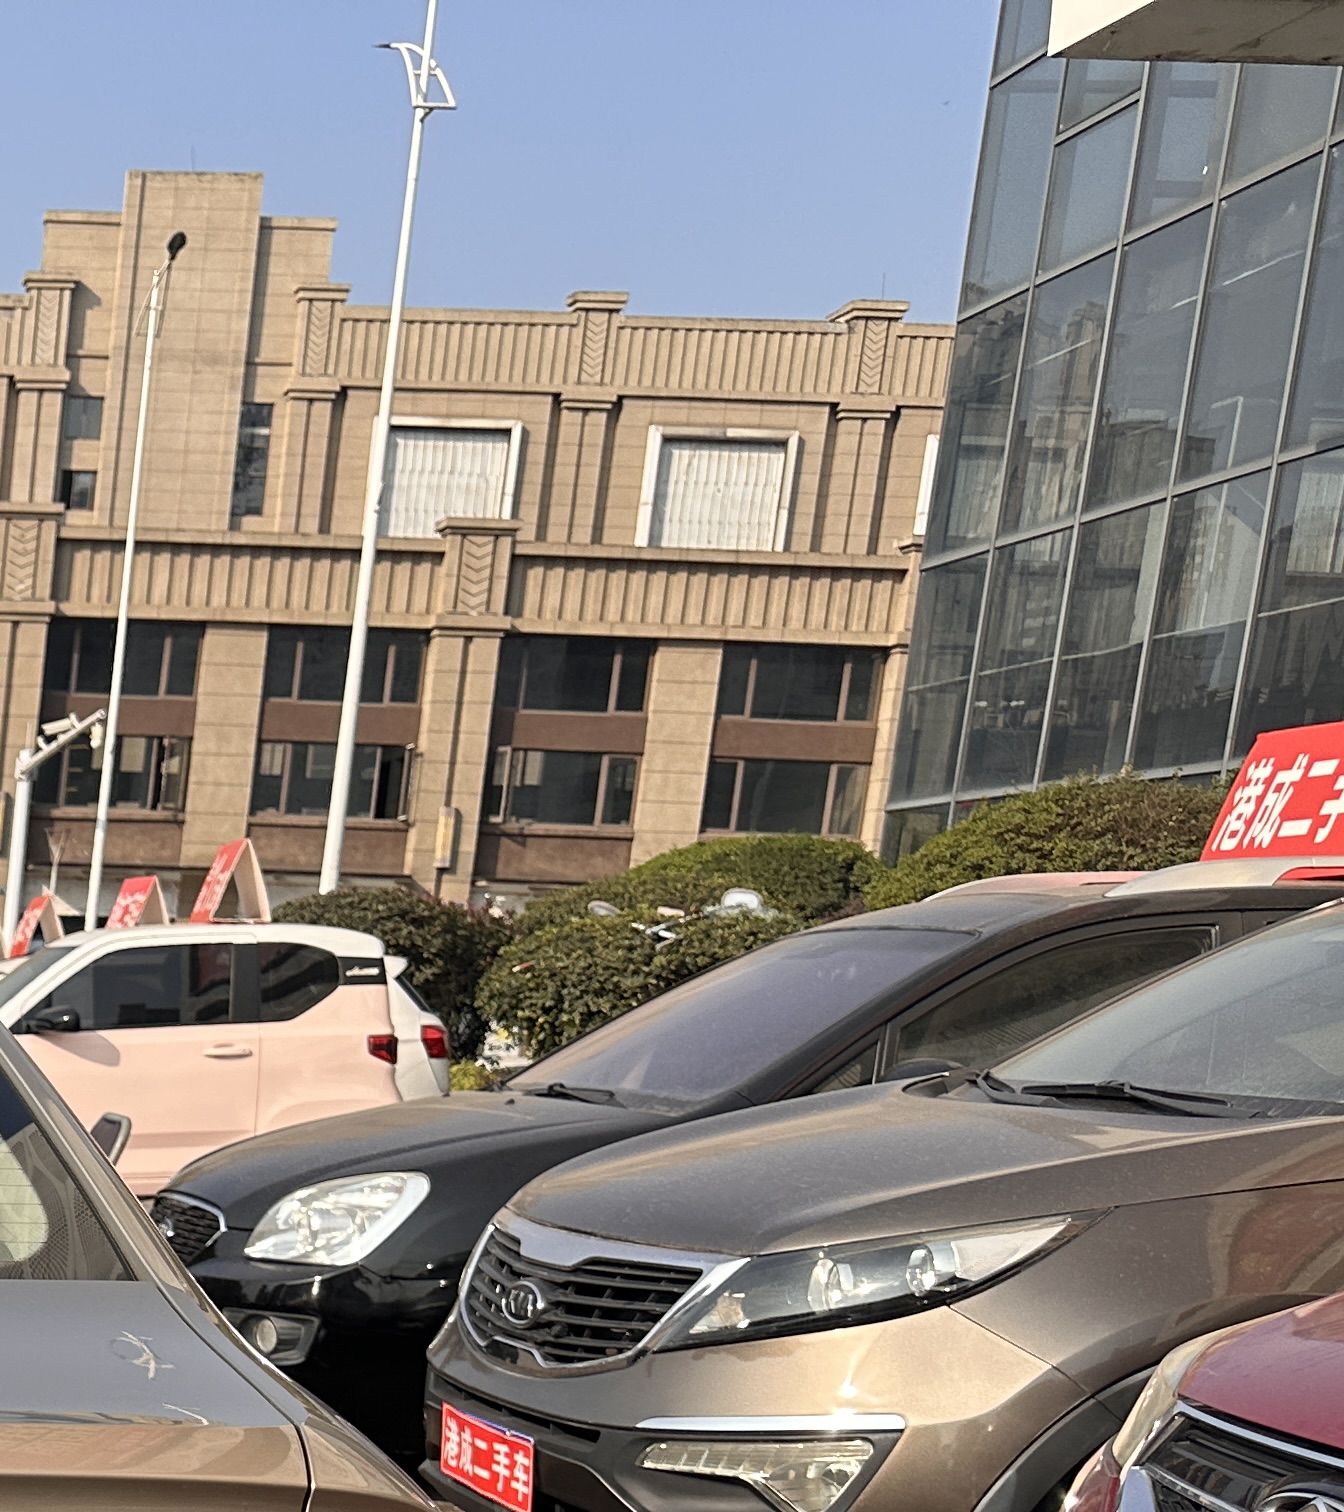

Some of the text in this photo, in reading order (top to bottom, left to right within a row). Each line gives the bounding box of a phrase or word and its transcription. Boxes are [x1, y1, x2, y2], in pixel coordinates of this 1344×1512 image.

[443, 1416, 531, 1503] 港成二手车
